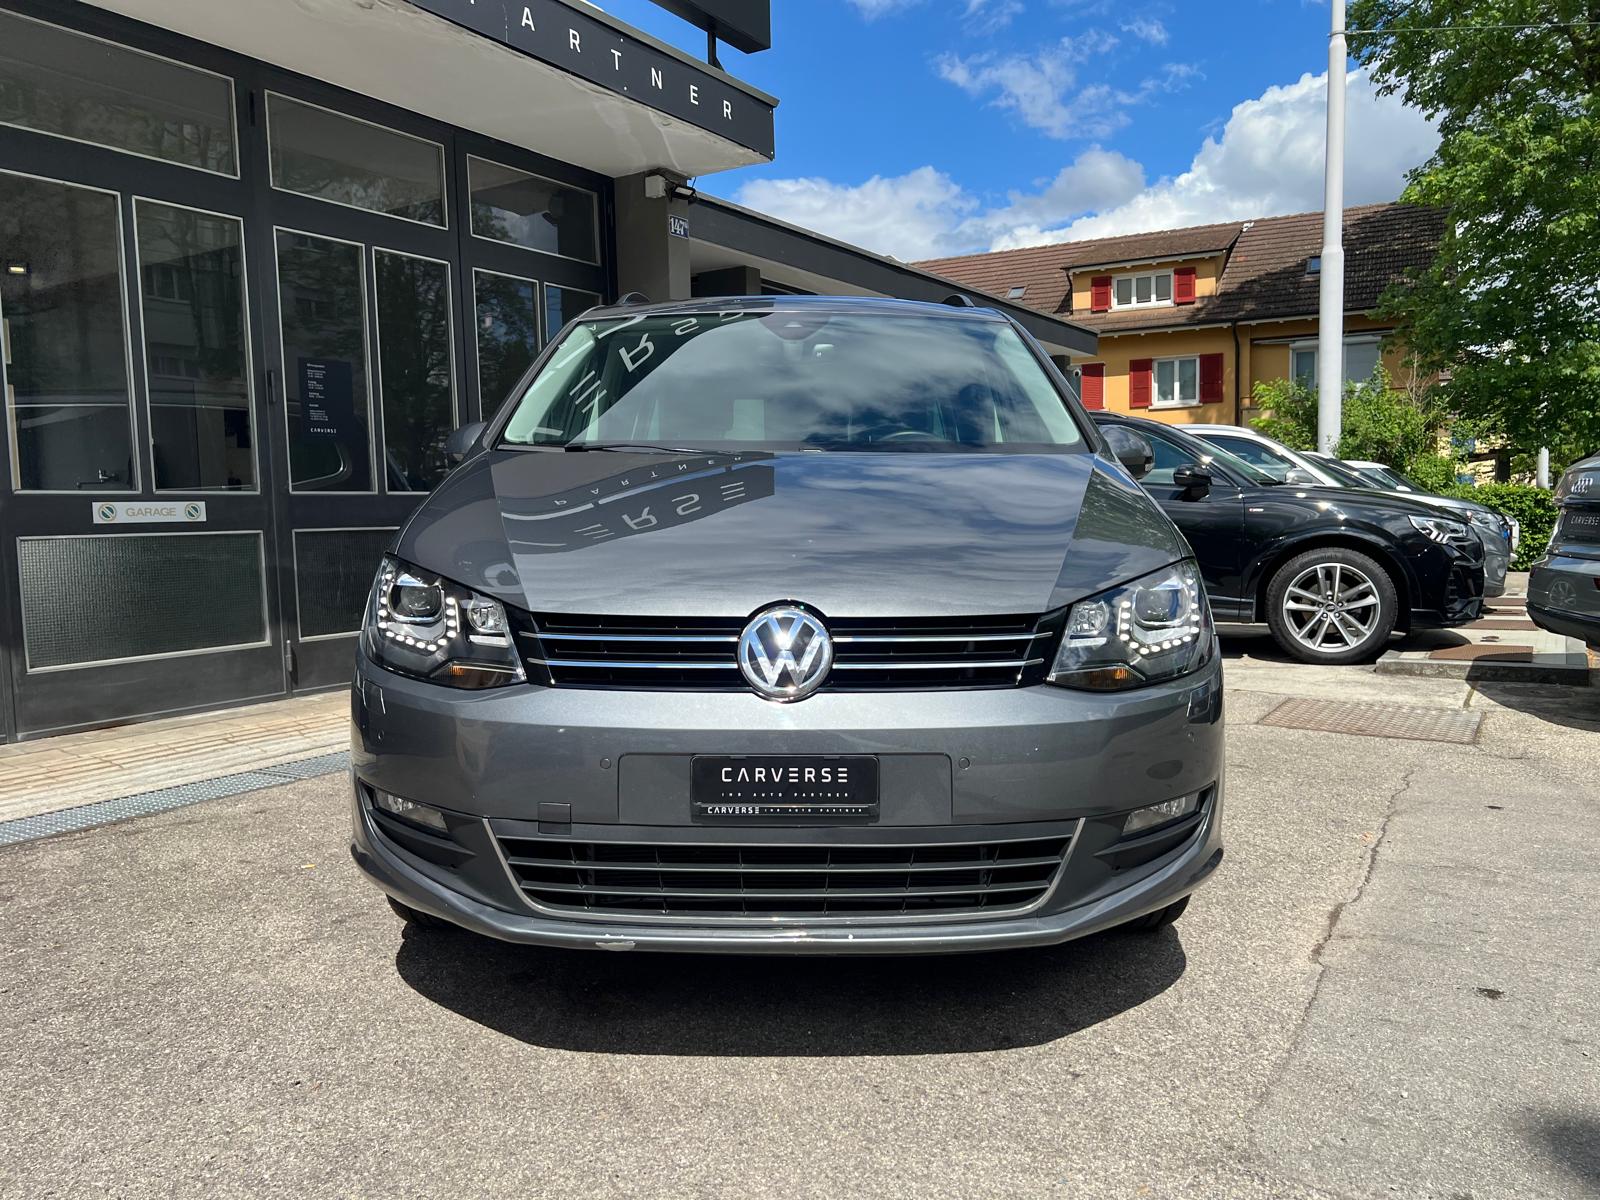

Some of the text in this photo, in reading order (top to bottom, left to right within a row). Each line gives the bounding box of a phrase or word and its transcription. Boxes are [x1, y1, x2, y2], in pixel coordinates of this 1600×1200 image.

[470, 0, 732, 120] ARTNER
[126, 507, 176, 517] GARAGE
[721, 767, 848, 783] CARVERSE
[707, 806, 760, 814] CARVERSE
